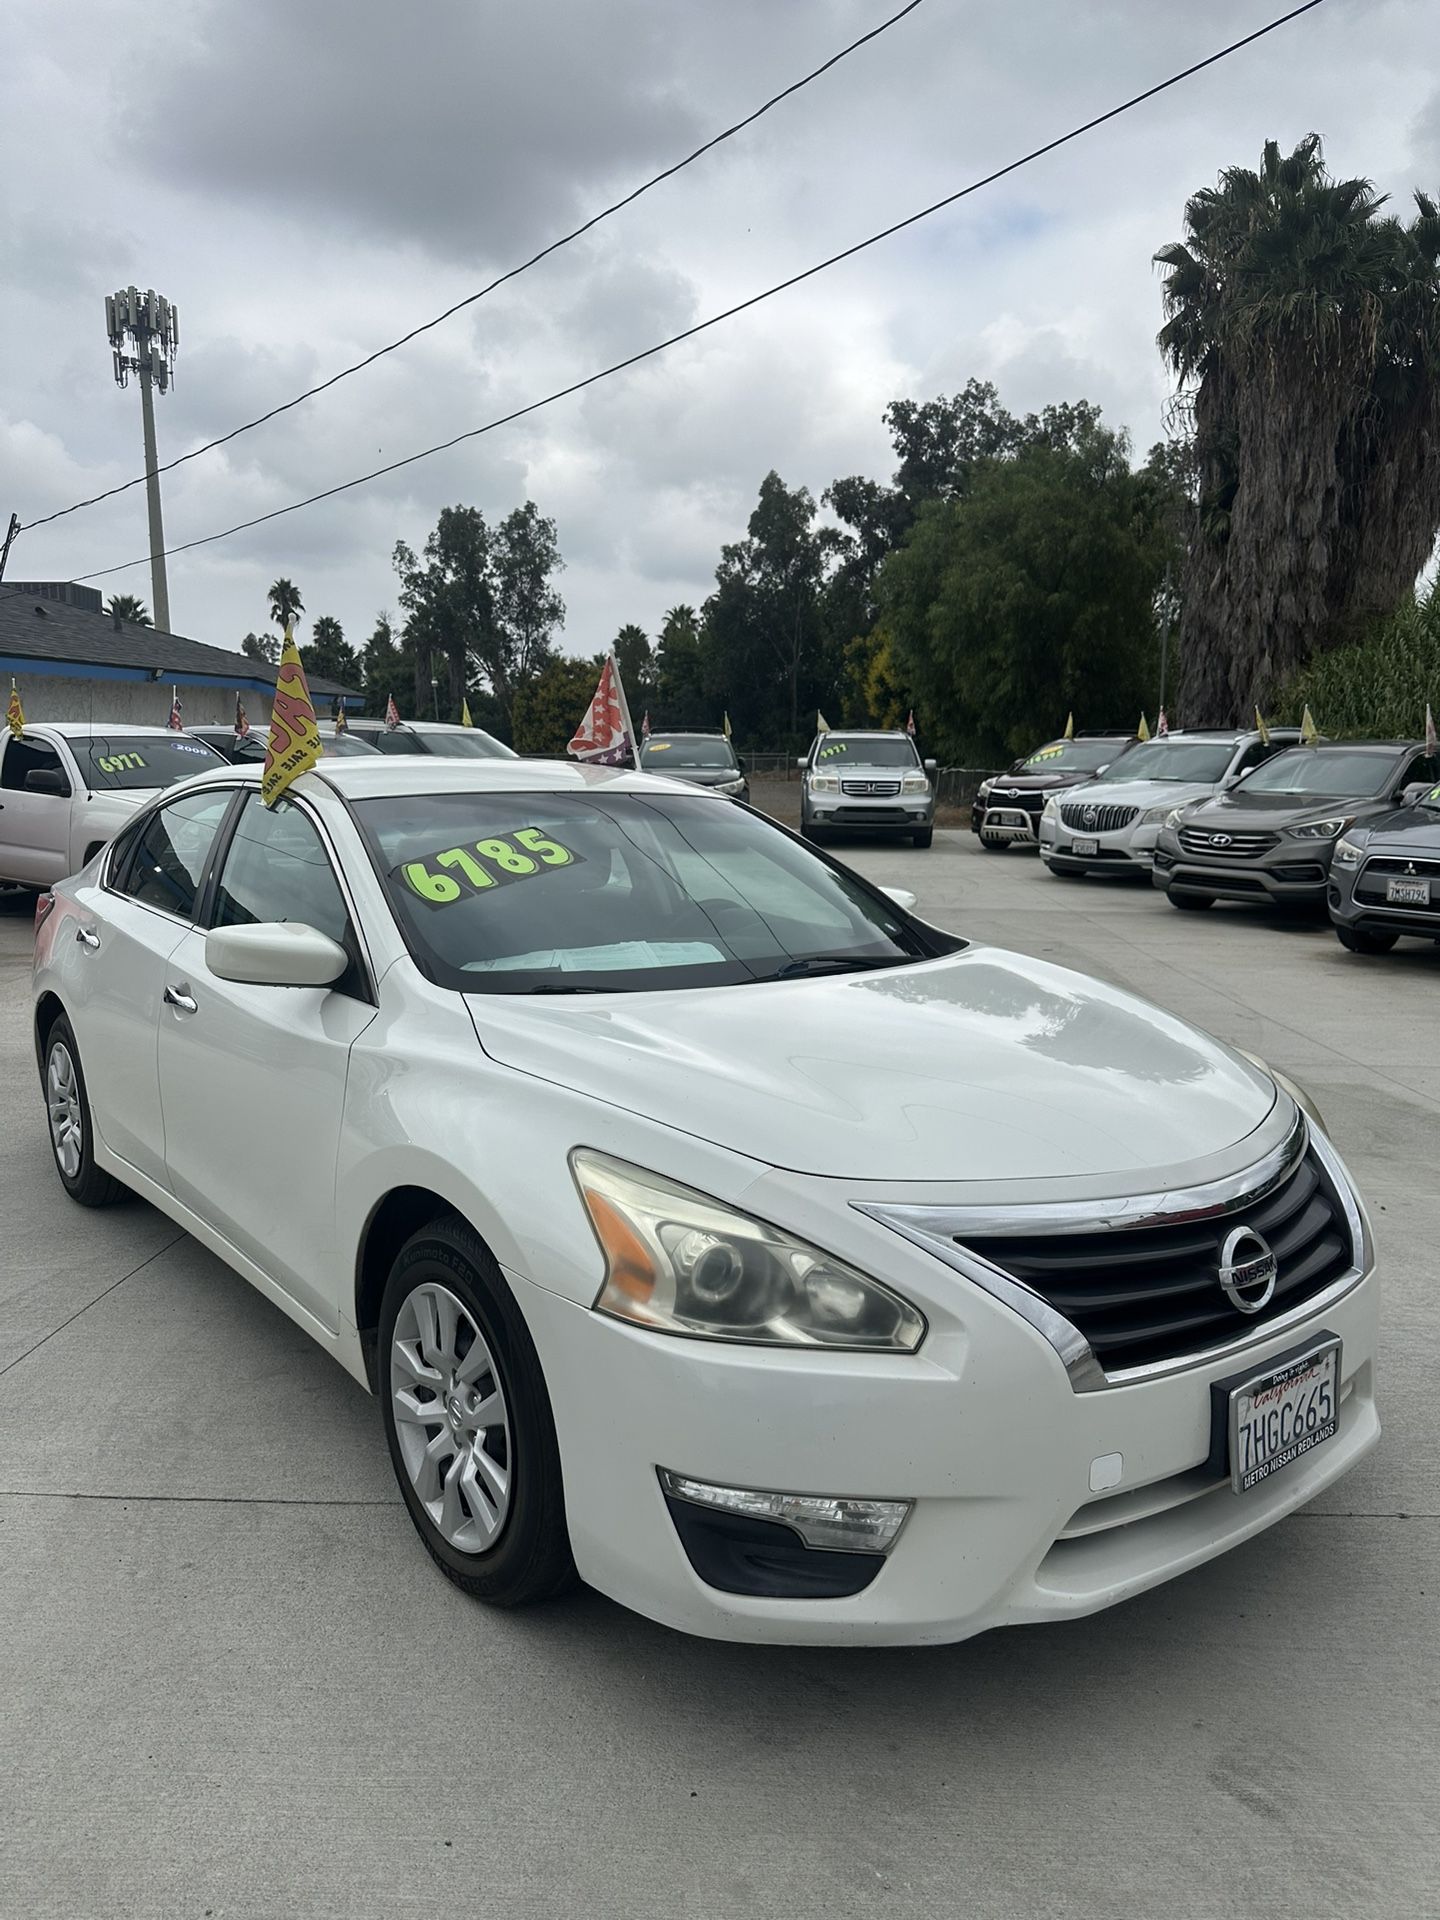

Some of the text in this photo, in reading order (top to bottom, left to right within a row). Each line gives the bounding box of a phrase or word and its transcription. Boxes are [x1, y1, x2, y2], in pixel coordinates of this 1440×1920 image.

[98, 752, 147, 773] 6977
[176, 743, 208, 755] 2009
[400, 828, 575, 903] 6785
[1231, 1256, 1276, 1285] NISSAN
[1253, 1367, 1321, 1409] California
[1272, 1370, 1288, 1385] Doing
[1239, 1379, 1331, 1471] 7HGC665
[1243, 1423, 1335, 1490] METRO NISSAN REDLANDS
